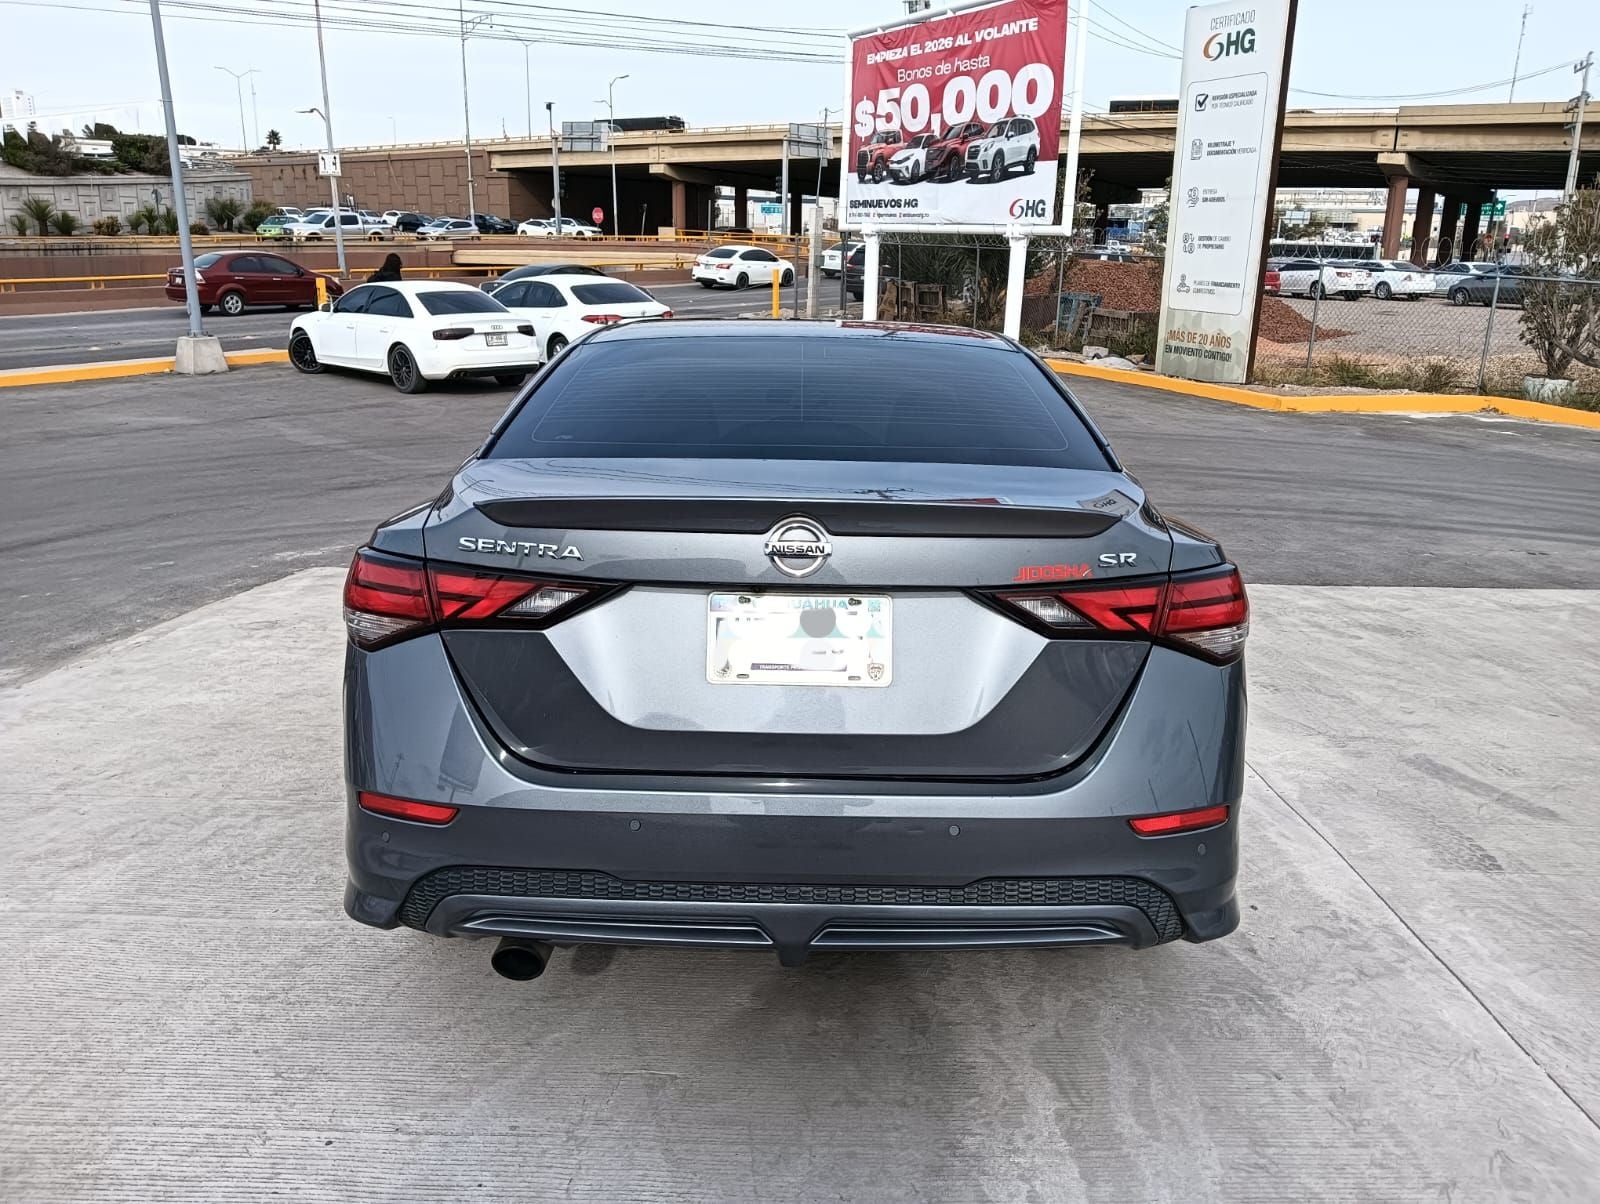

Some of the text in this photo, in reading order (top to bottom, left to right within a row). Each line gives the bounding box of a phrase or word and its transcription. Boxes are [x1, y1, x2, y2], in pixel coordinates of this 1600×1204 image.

[1210, 10, 1256, 31] CERTIFICADO
[867, 18, 1038, 64] EMPIEZA EL 2026 AL VOLANTE
[1225, 28, 1256, 56] HG
[898, 54, 991, 83] Bonos de hasta
[854, 62, 1055, 141] $50,000
[849, 198, 918, 209] SEMINUEVOS HG
[1025, 199, 1046, 217] HG
[1166, 328, 1232, 349] ¡MÁS DE 20 AÑOS
[1165, 344, 1232, 362] EN MOVIENTO CONTIGO!
[458, 536, 584, 561] SENTRA
[771, 544, 825, 554] NISSAN
[1098, 552, 1137, 568] SR
[1013, 563, 1093, 582] JIDOSHA
